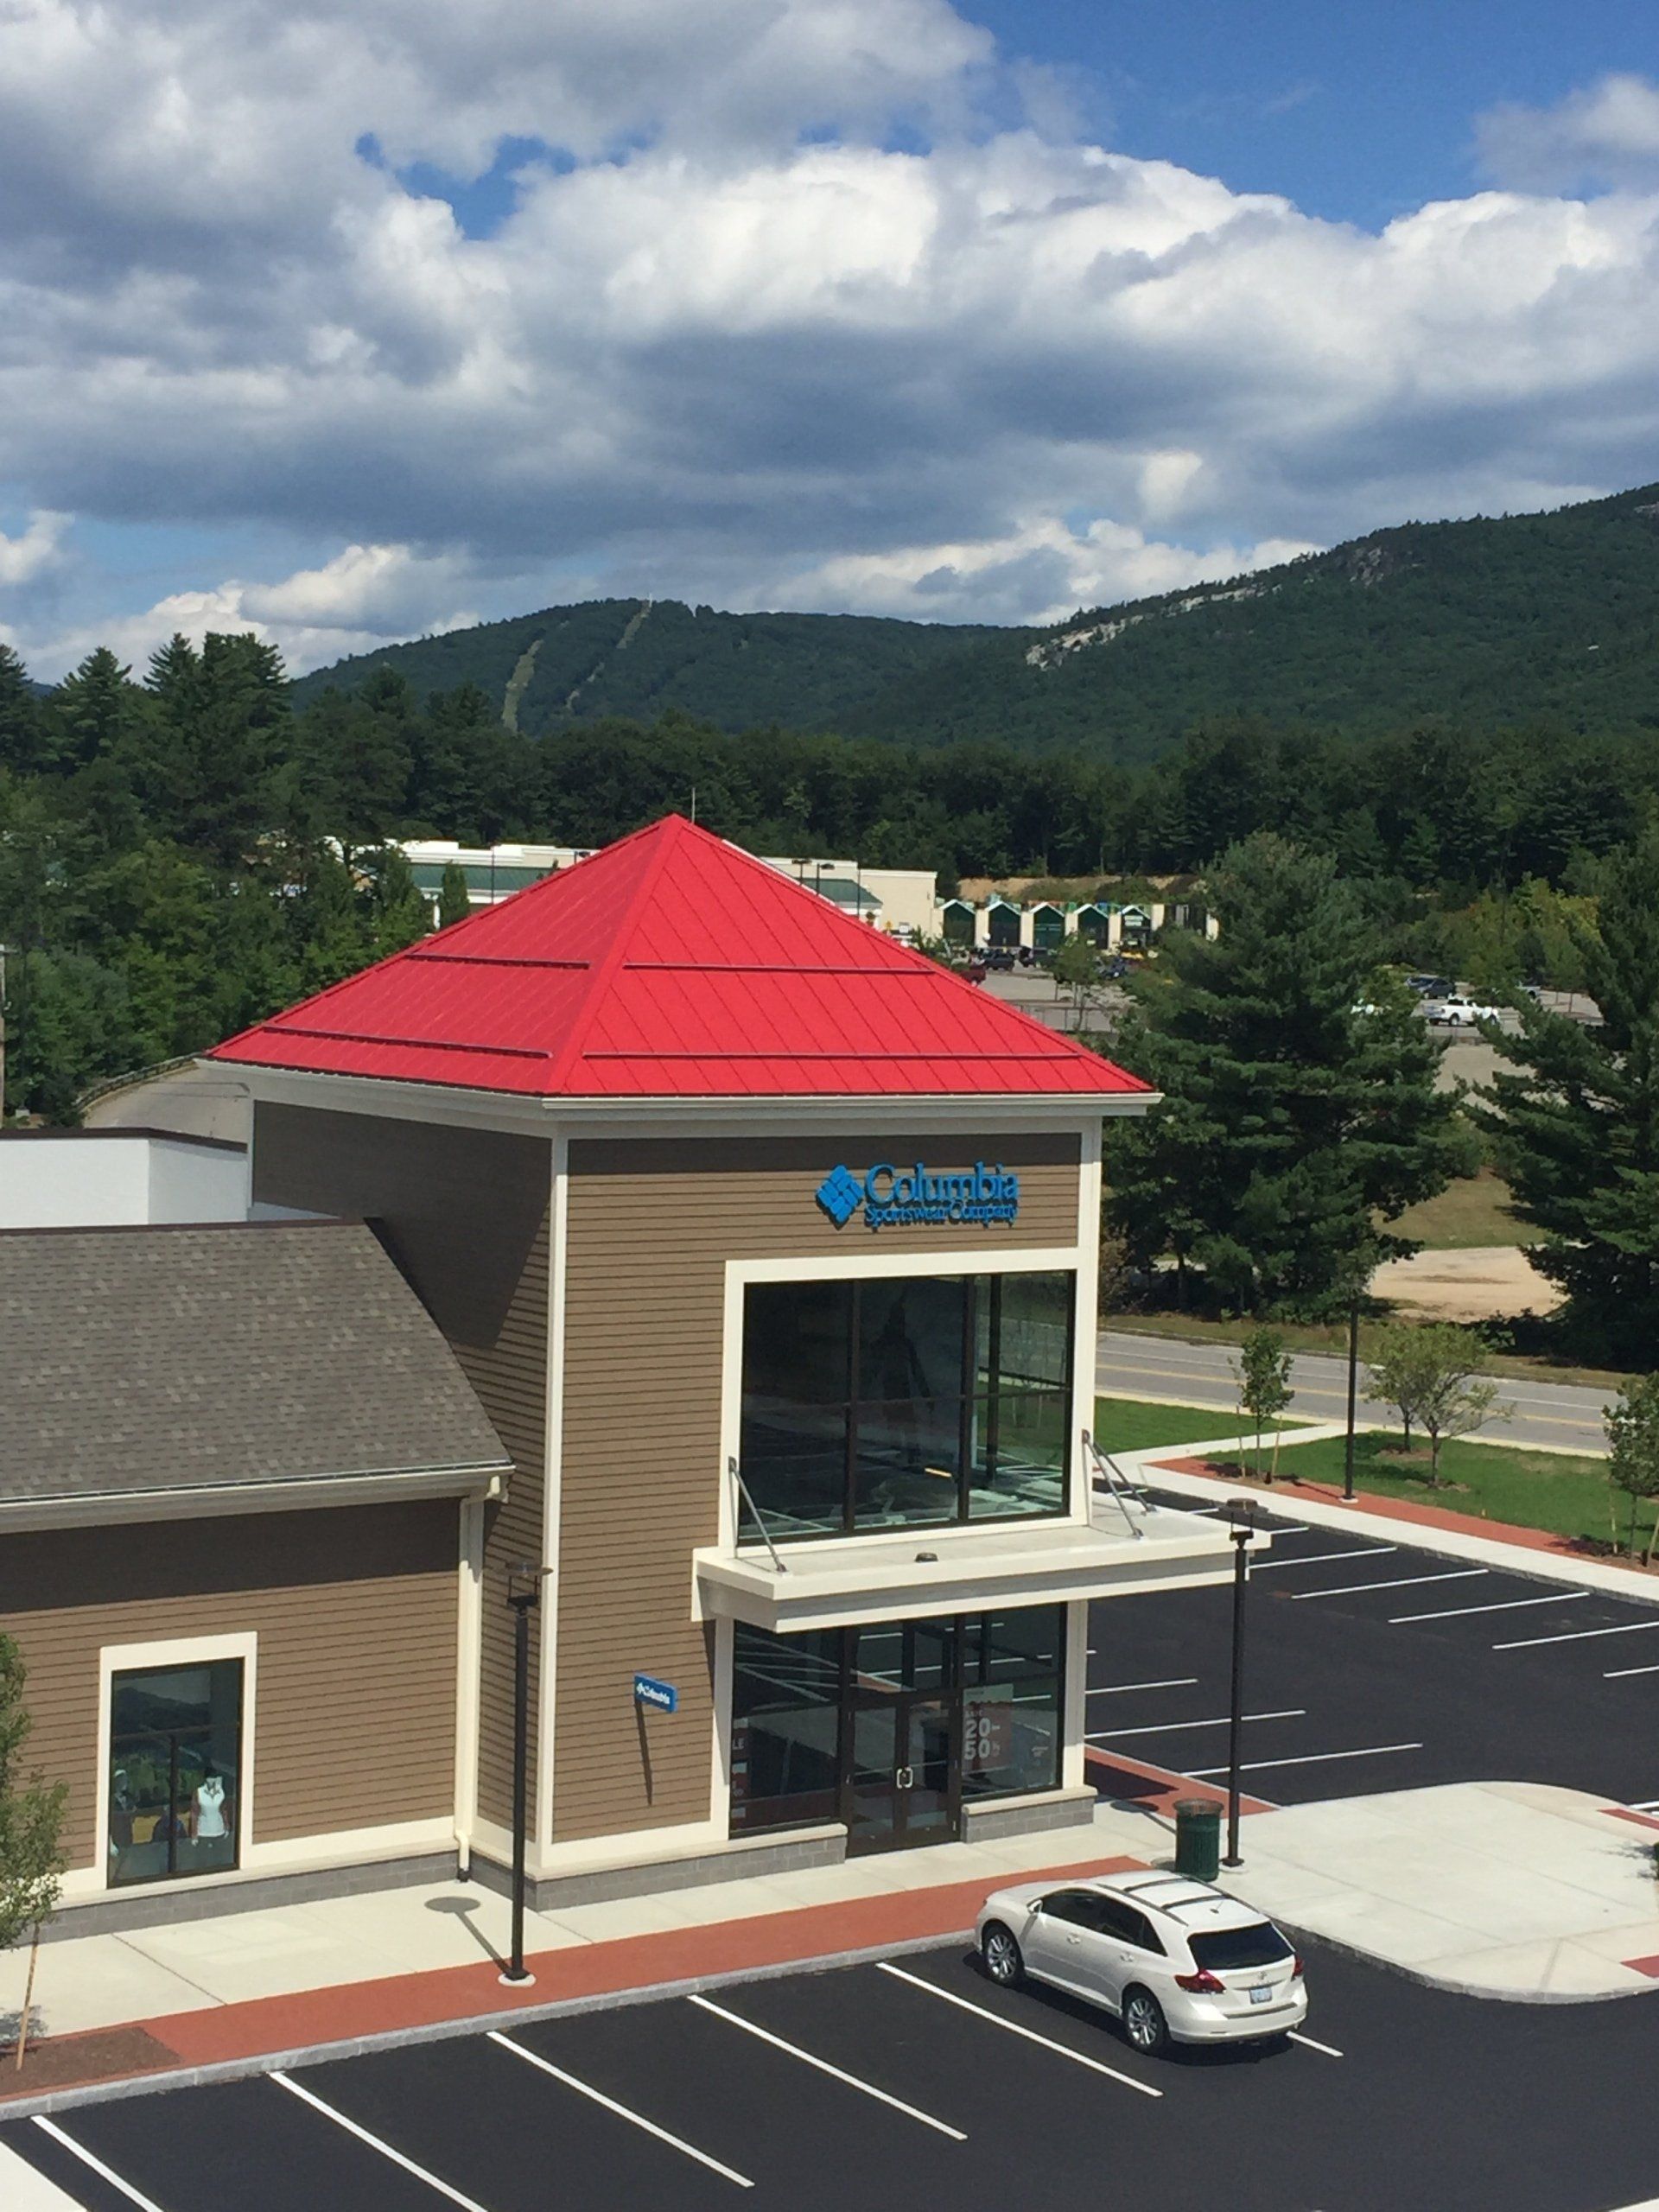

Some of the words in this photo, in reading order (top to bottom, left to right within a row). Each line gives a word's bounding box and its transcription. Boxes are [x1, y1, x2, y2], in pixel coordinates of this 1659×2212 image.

[864, 1160, 1019, 1205] Columbia
[865, 1204, 948, 1228] Sportswear
[950, 1199, 1020, 1225] Company
